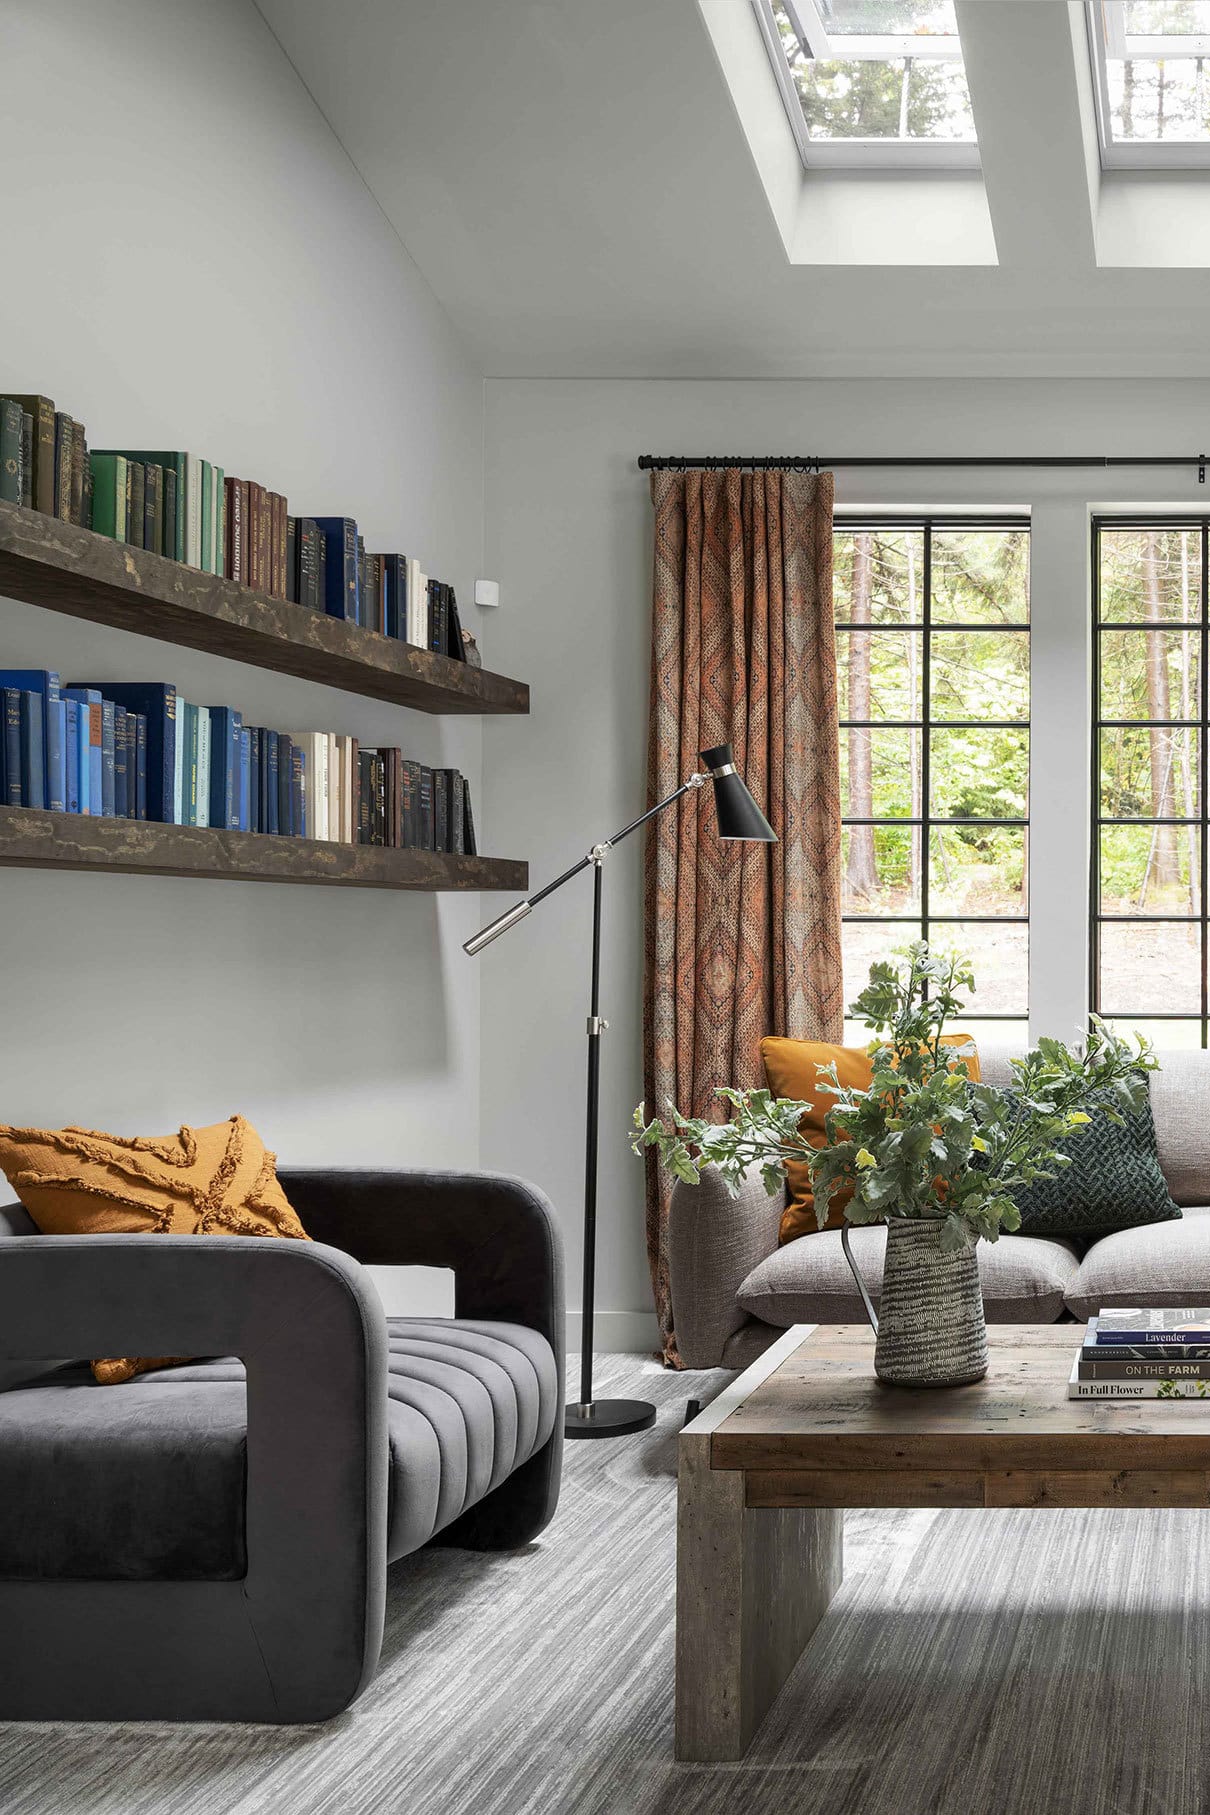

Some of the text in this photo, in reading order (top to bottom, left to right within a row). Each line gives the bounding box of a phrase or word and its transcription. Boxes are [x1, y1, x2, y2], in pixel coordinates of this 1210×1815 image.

[1145, 1332, 1186, 1343] Lavender
[1125, 1365, 1200, 1375] ON THE FARM
[1078, 1384, 1145, 1395] In Full Flower
